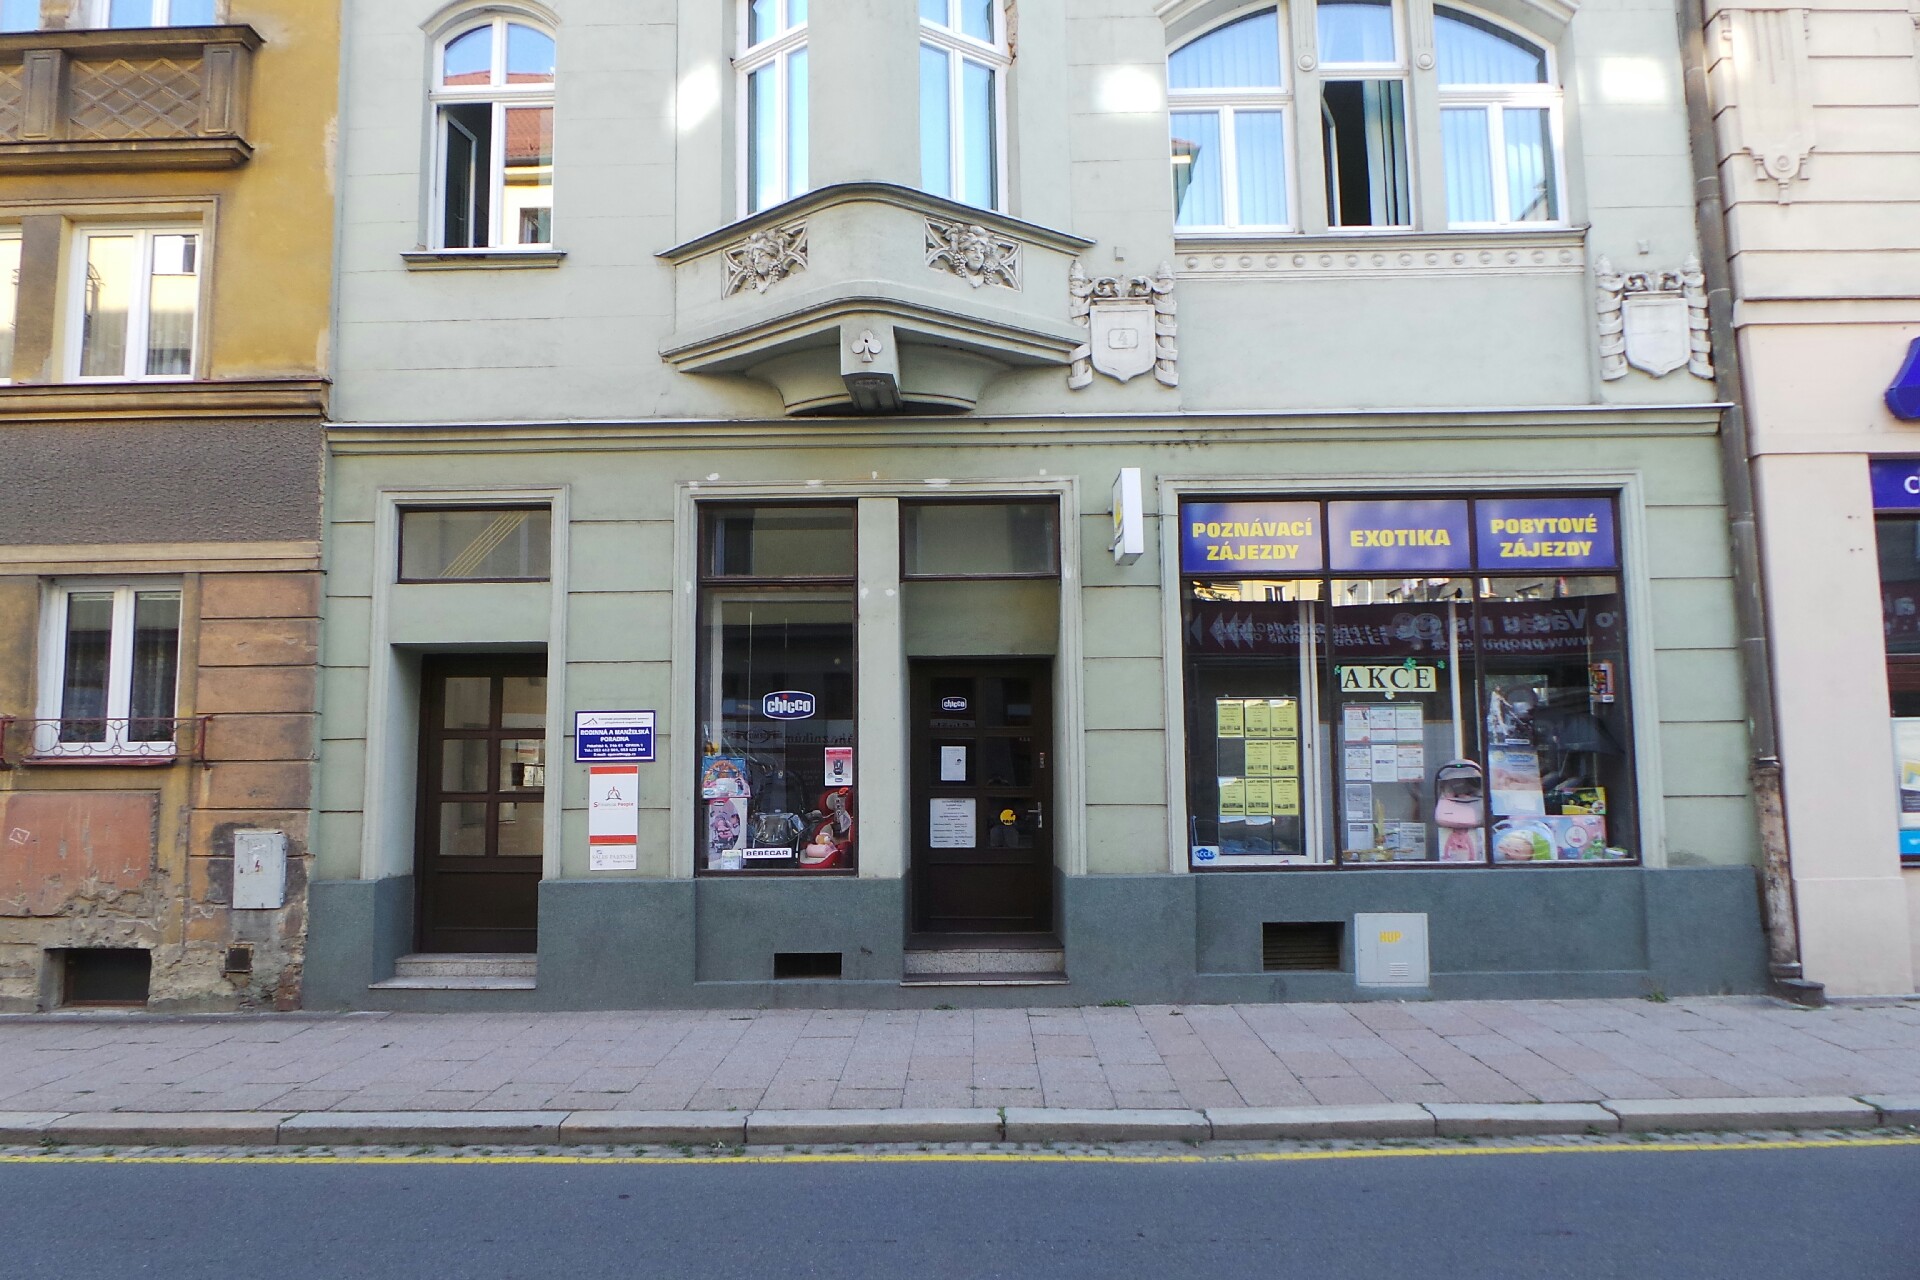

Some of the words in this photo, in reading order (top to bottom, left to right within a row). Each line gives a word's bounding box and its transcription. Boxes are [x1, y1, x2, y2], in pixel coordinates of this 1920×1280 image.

[1192, 517, 1313, 538] POZNÁVACÍ
[1491, 513, 1598, 534] POBYTOVÉ
[1350, 529, 1452, 547] EXOTIKA
[1500, 538, 1593, 558] ZÁJEZDY
[1206, 540, 1299, 560] ZÁJEZDY
[1342, 667, 1431, 689] AKCE
[767, 694, 811, 714] chicco
[943, 699, 965, 708] chicco
